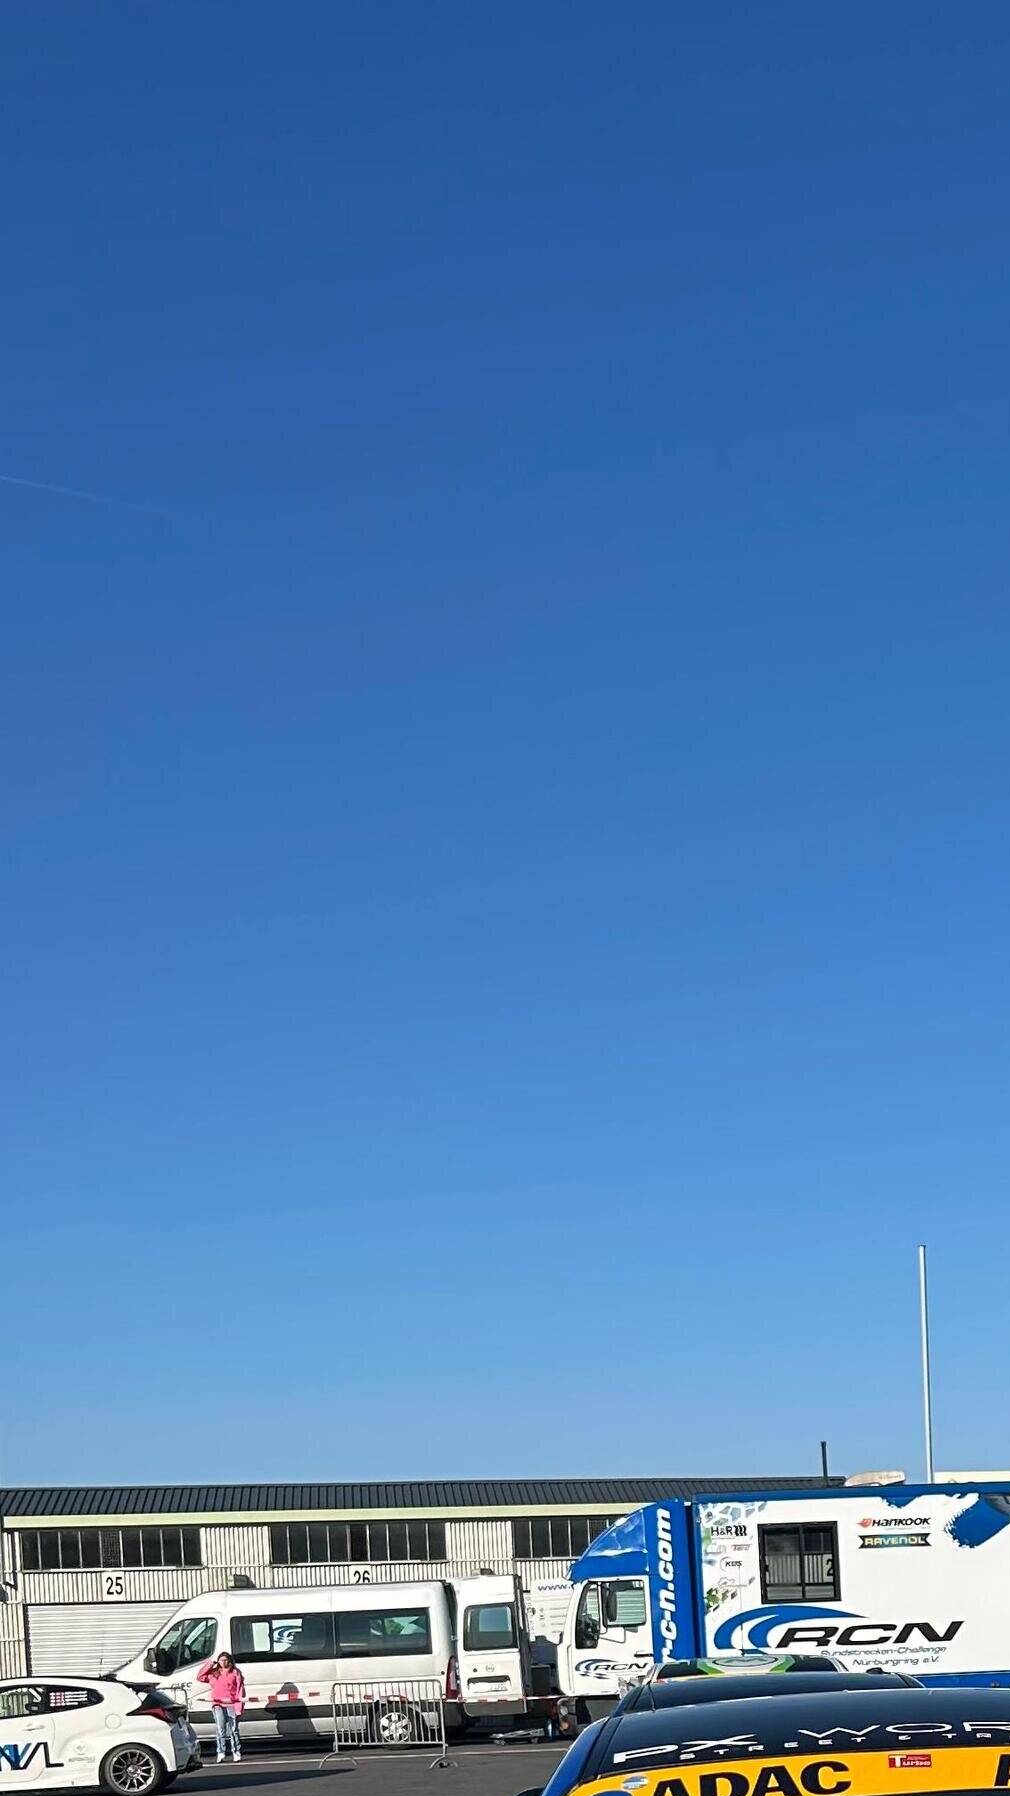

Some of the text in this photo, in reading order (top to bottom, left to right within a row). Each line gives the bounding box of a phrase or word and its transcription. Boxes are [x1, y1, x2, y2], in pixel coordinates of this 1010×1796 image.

[864, 1536, 926, 1546] RAVENOL
[106, 1576, 124, 1595] 25
[775, 1621, 965, 1649] RCN
[594, 1662, 649, 1671] RCN
[613, 1734, 757, 1764] PX
[679, 1736, 866, 1760] STREET
